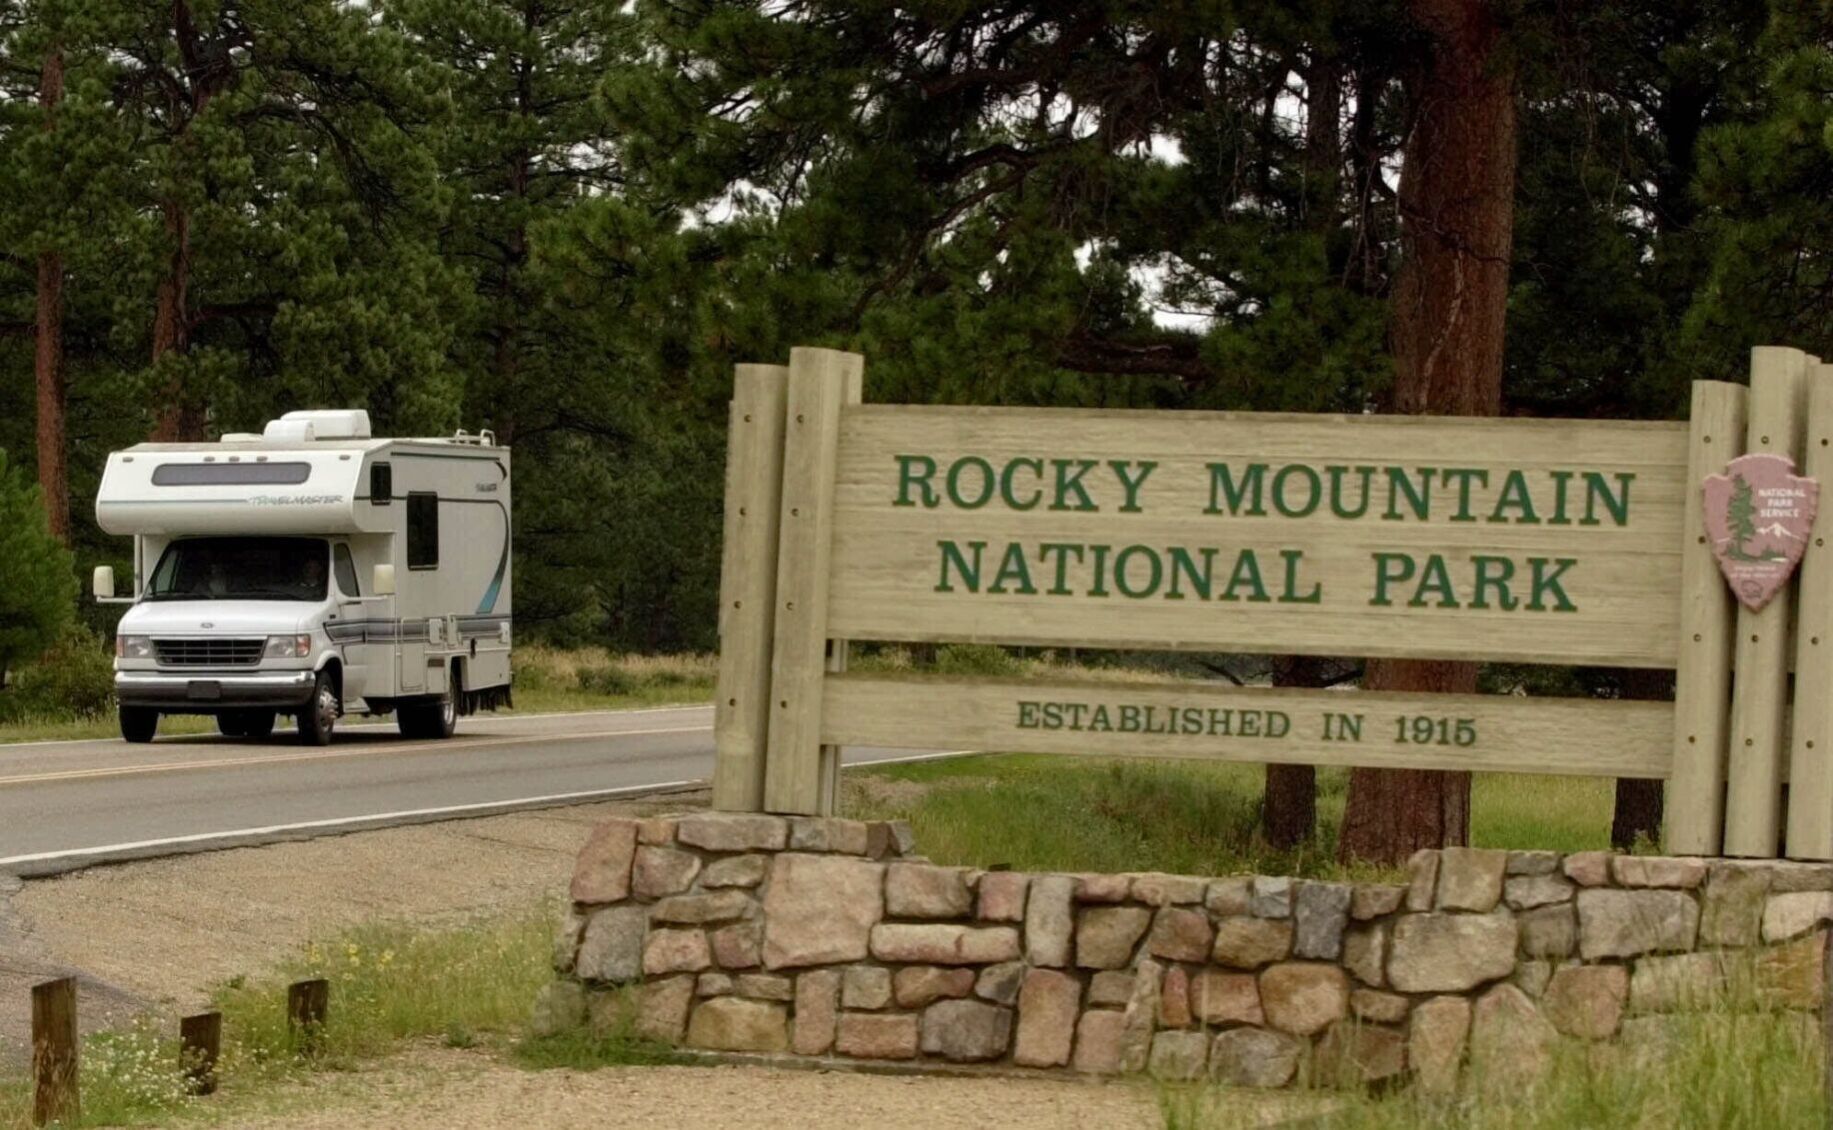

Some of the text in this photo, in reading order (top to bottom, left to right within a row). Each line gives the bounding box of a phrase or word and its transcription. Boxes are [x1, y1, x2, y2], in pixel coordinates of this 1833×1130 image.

[893, 455, 1636, 526] ROCKY MOUNTAIN
[1758, 487, 1806, 498] NATIONAL
[1767, 498, 1793, 507] PARK
[1760, 508, 1799, 518] SERVICE
[934, 540, 1578, 613] NATIONAL PARK
[1014, 701, 1477, 746] ESTABLISHED IN 1915
